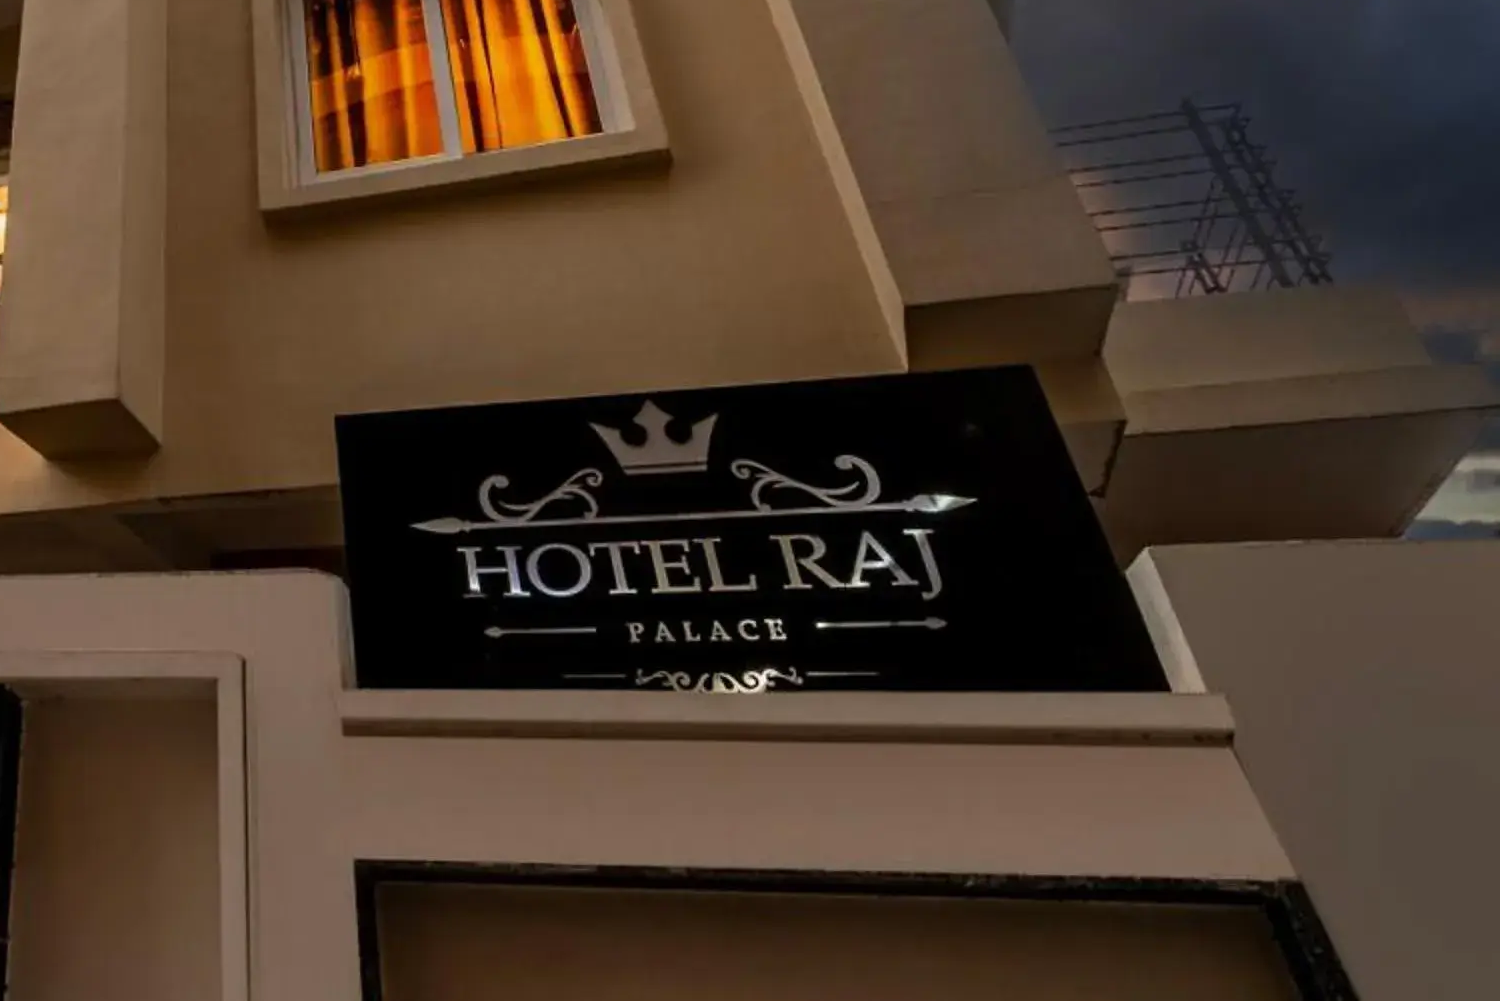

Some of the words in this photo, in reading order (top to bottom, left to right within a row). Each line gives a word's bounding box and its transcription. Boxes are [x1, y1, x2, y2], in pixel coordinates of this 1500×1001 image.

[457, 537, 757, 598] HOTEL
[769, 528, 943, 600] RAJ
[626, 617, 788, 644] PALACE
